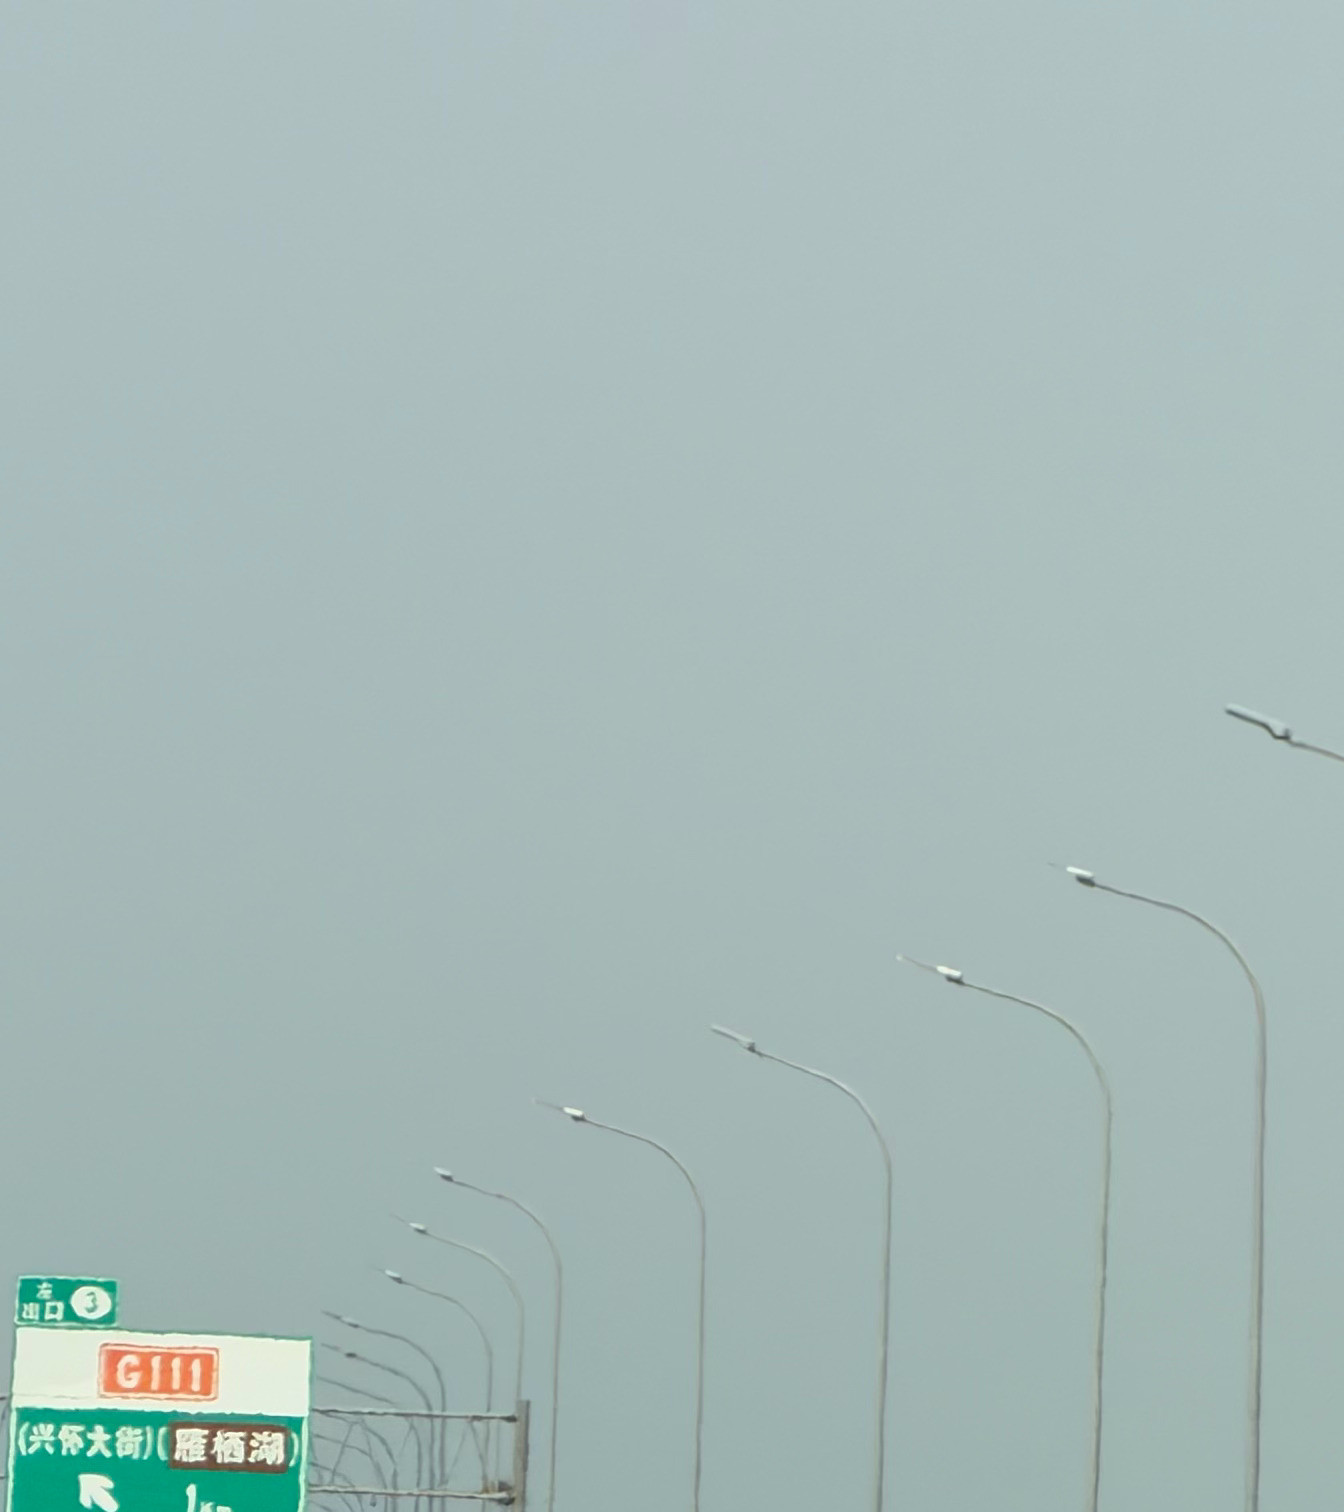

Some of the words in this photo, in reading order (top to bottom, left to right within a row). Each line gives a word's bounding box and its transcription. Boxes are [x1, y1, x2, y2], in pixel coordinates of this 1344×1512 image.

[21, 1301, 65, 1321] 出口
[84, 1291, 98, 1314] 3
[117, 1353, 202, 1392] G111
